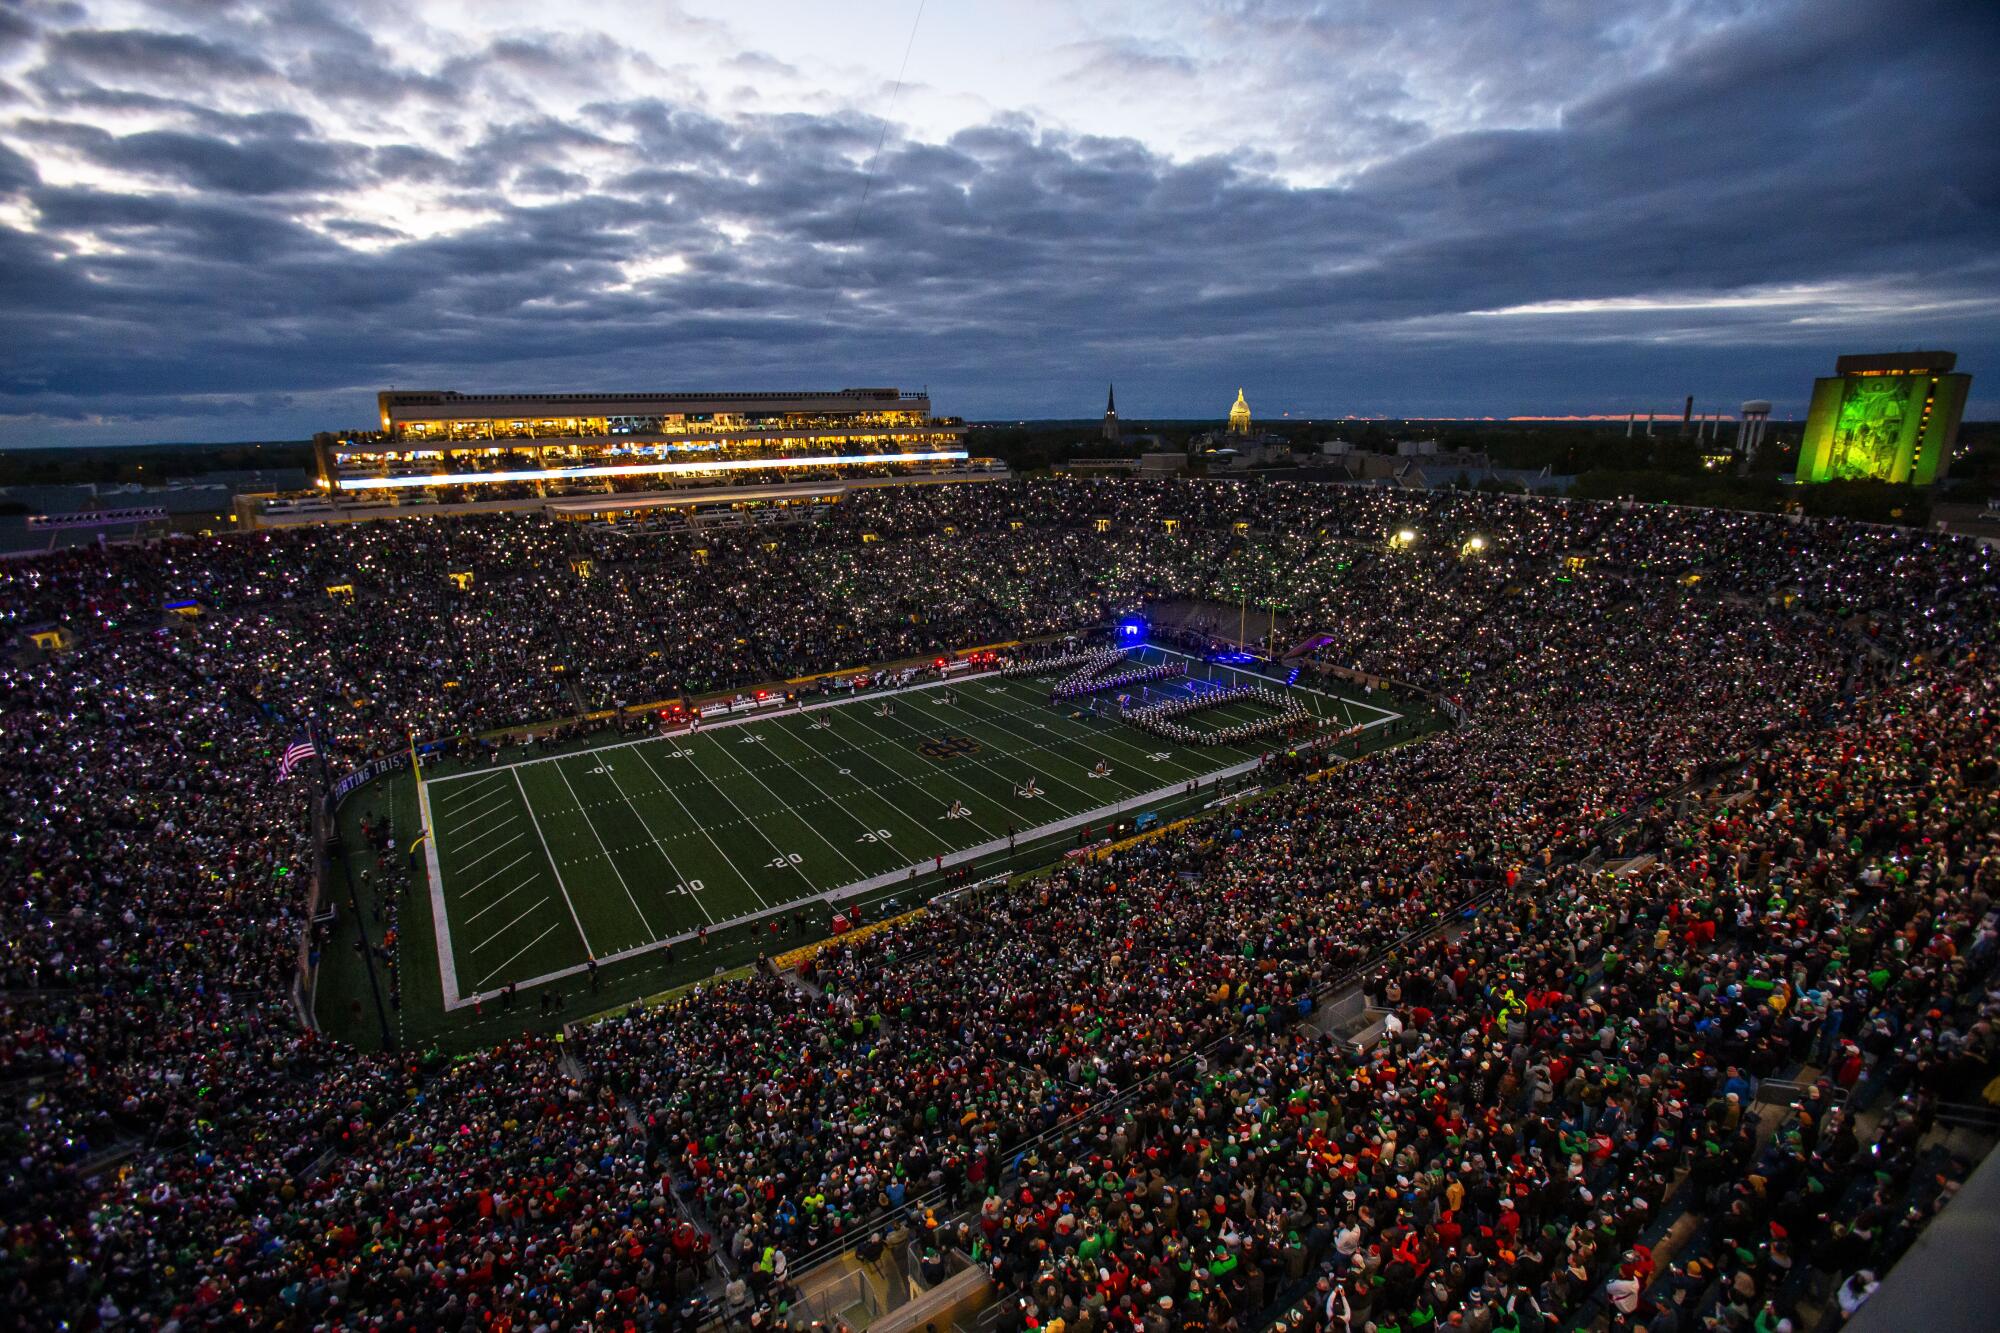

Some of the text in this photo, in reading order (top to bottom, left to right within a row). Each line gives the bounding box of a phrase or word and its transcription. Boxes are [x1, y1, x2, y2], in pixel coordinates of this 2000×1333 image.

[672, 749, 695, 758] 20
[593, 764, 615, 774] 10
[862, 829, 893, 843] 30
[771, 853, 803, 869] 20
[676, 879, 705, 895] 10
